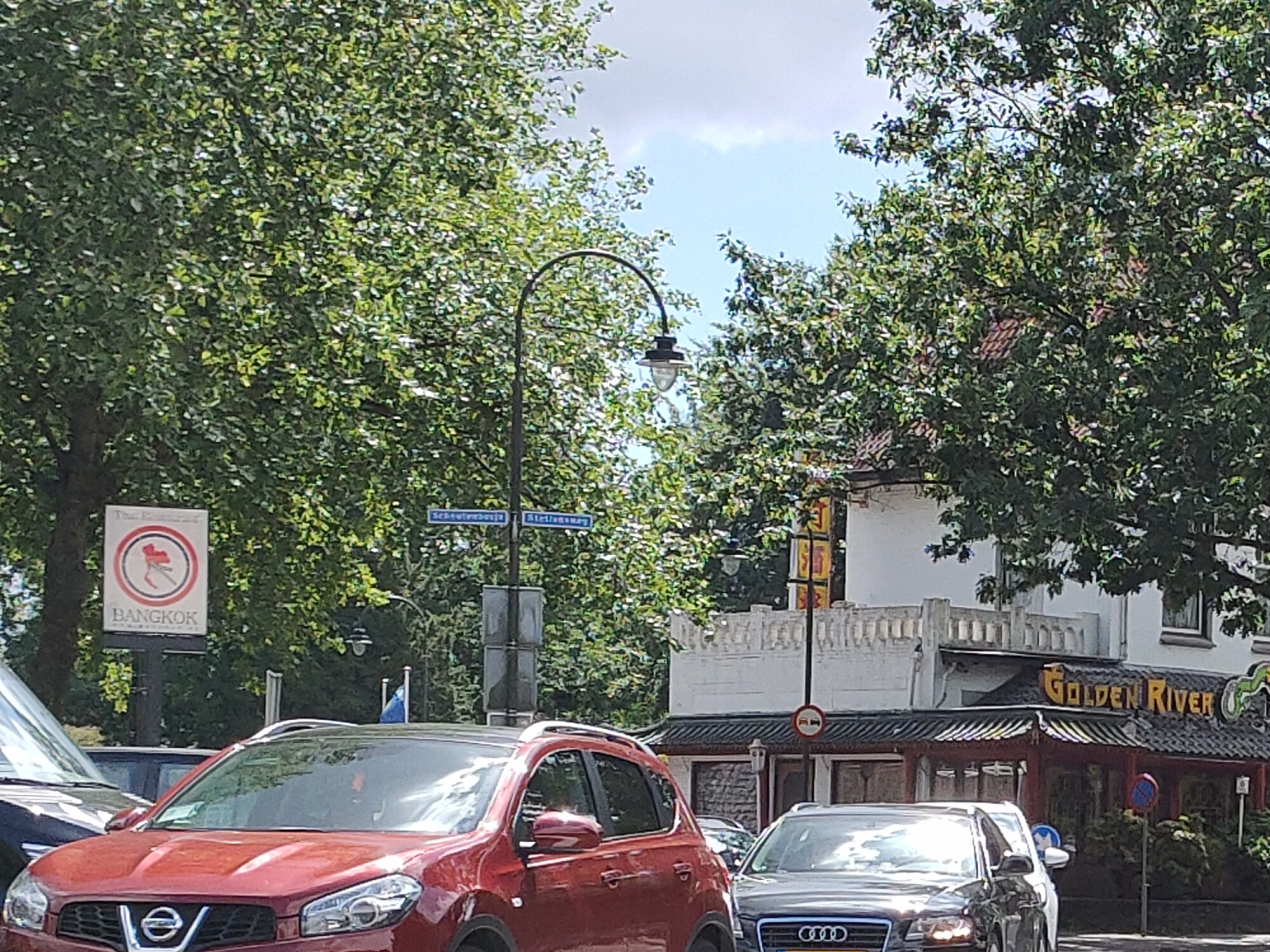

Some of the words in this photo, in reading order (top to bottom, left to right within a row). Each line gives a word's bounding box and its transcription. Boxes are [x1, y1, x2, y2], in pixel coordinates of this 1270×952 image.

[112, 607, 198, 625] BANGKOK
[1040, 663, 1140, 711] GOLDEN
[1146, 678, 1215, 716] RIVER
